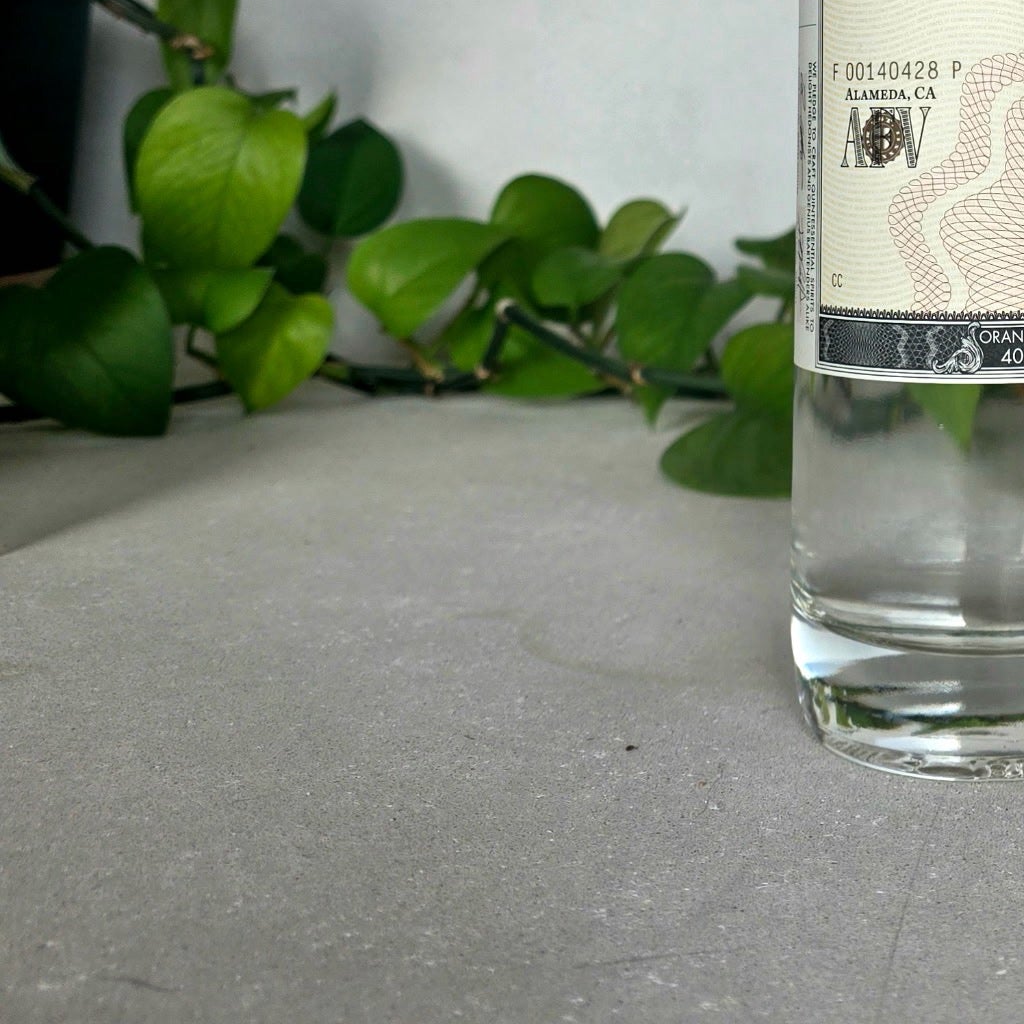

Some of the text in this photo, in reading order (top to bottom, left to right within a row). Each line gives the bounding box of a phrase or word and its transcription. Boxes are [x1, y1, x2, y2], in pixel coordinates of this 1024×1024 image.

[812, 62, 817, 78] WE
[833, 60, 962, 80] F 00140428 P
[914, 86, 936, 100] CA
[812, 127, 817, 140] TO
[832, 272, 843, 288] CC
[810, 319, 814, 332] TO
